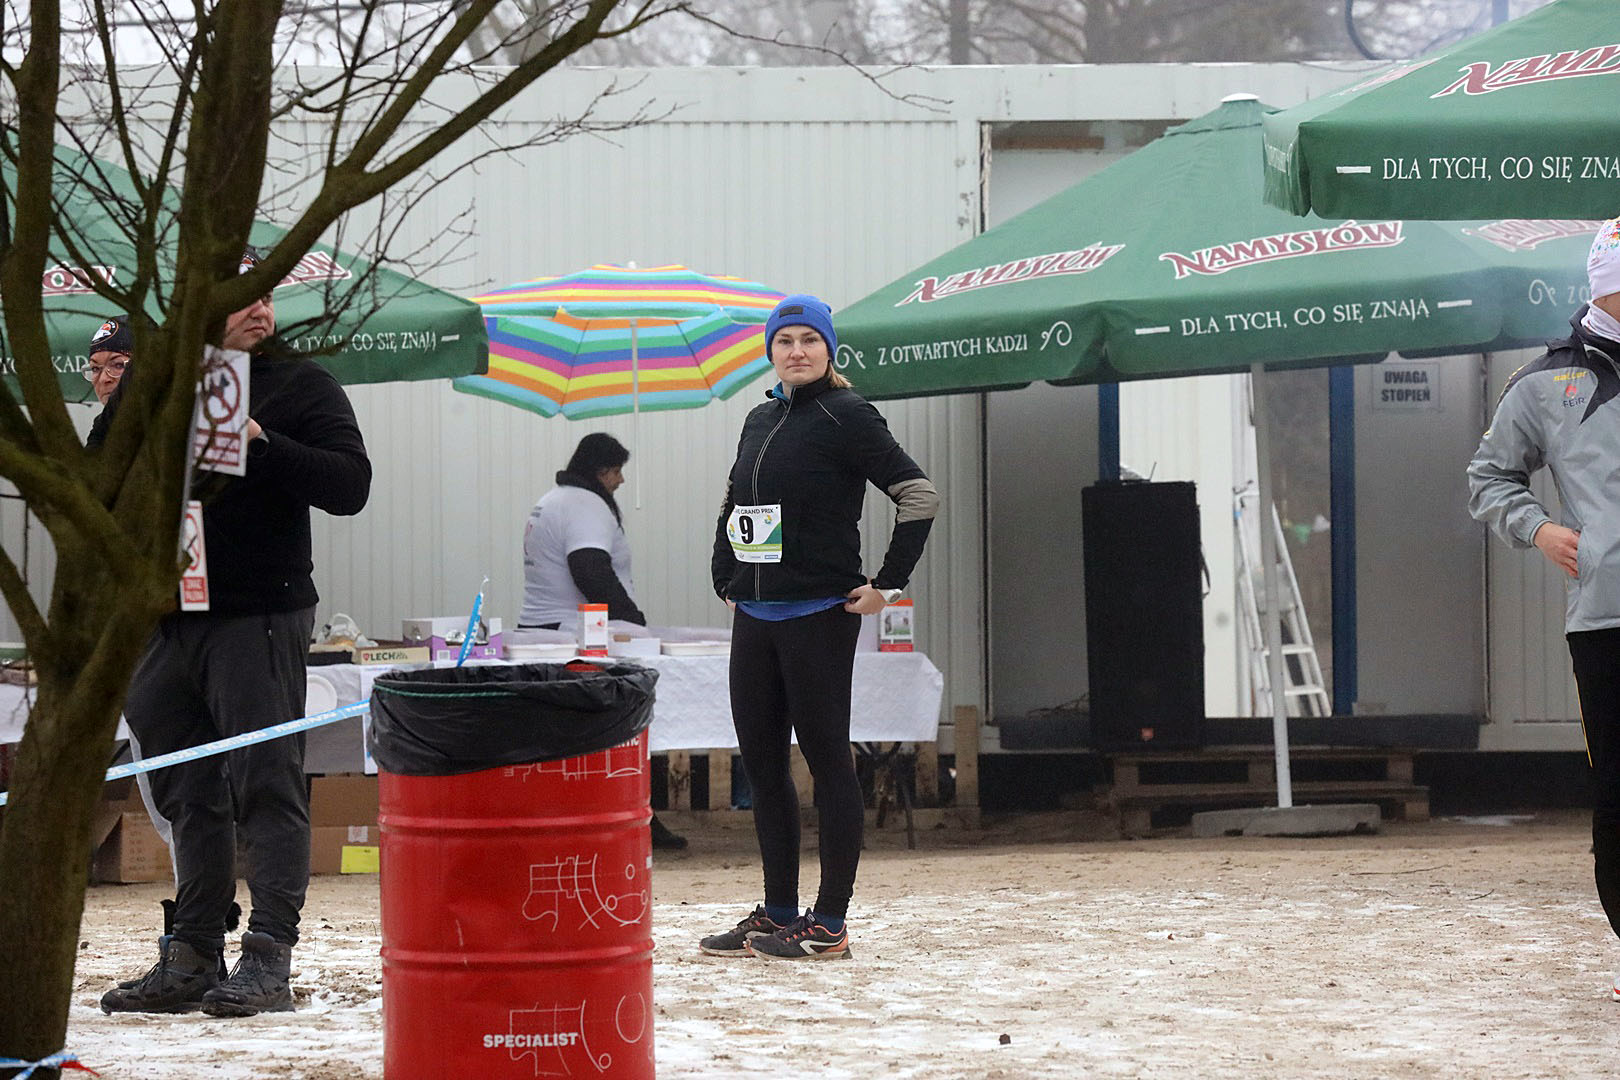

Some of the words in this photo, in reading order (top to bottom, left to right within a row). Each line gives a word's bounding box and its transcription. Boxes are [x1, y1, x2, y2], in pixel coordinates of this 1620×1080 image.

[1430, 44, 1620, 98] NAMY
[1383, 157, 1421, 179] DLA
[1429, 157, 1492, 181] TYCH,
[1500, 157, 1533, 179] CO
[1541, 156, 1573, 183] SIĘ
[1159, 219, 1406, 279] NAMYSŁÓW
[1180, 316, 1220, 336] DLA
[1225, 311, 1287, 332] TYCH,
[1294, 307, 1326, 325] CO
[1333, 303, 1363, 323] SIĘ
[1370, 299, 1430, 321] ZNAJĄ
[352, 333, 373, 351] CO
[377, 333, 397, 353] SIĘ
[401, 331, 437, 353] ZNAJĄ
[878, 347, 888, 366] Z
[890, 338, 981, 364] OTWARTYCH
[986, 334, 1028, 354] KADZI
[1384, 371, 1429, 384] UWAGA
[1381, 386, 1430, 402] STOPIEŃ
[739, 515, 754, 544] 9
[370, 651, 396, 661] LECH
[482, 1032, 579, 1048] SPECIALIST
